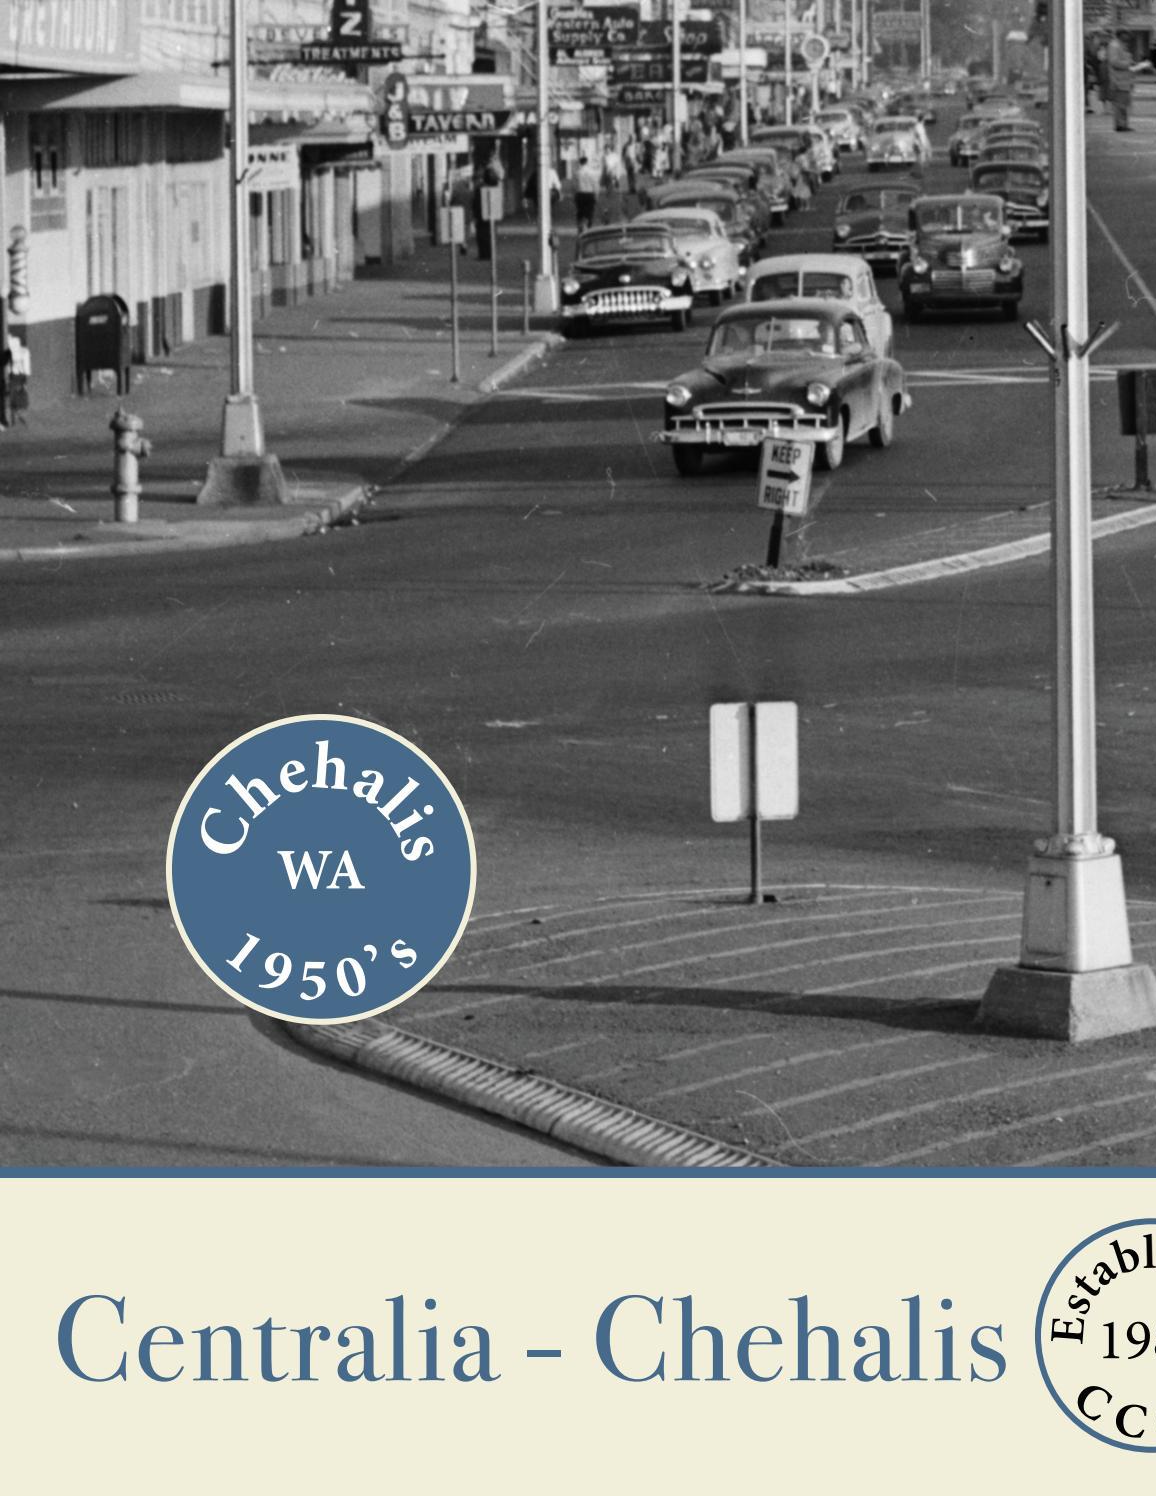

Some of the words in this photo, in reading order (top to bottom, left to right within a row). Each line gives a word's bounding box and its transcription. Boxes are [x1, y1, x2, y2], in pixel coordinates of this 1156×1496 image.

[604, 15, 635, 30] Auto
[553, 29, 603, 46] Supply
[302, 46, 400, 60] TREATMENTS
[411, 115, 496, 132] TAVERN
[771, 444, 801, 465] KEEP
[763, 484, 800, 508] RIGHT
